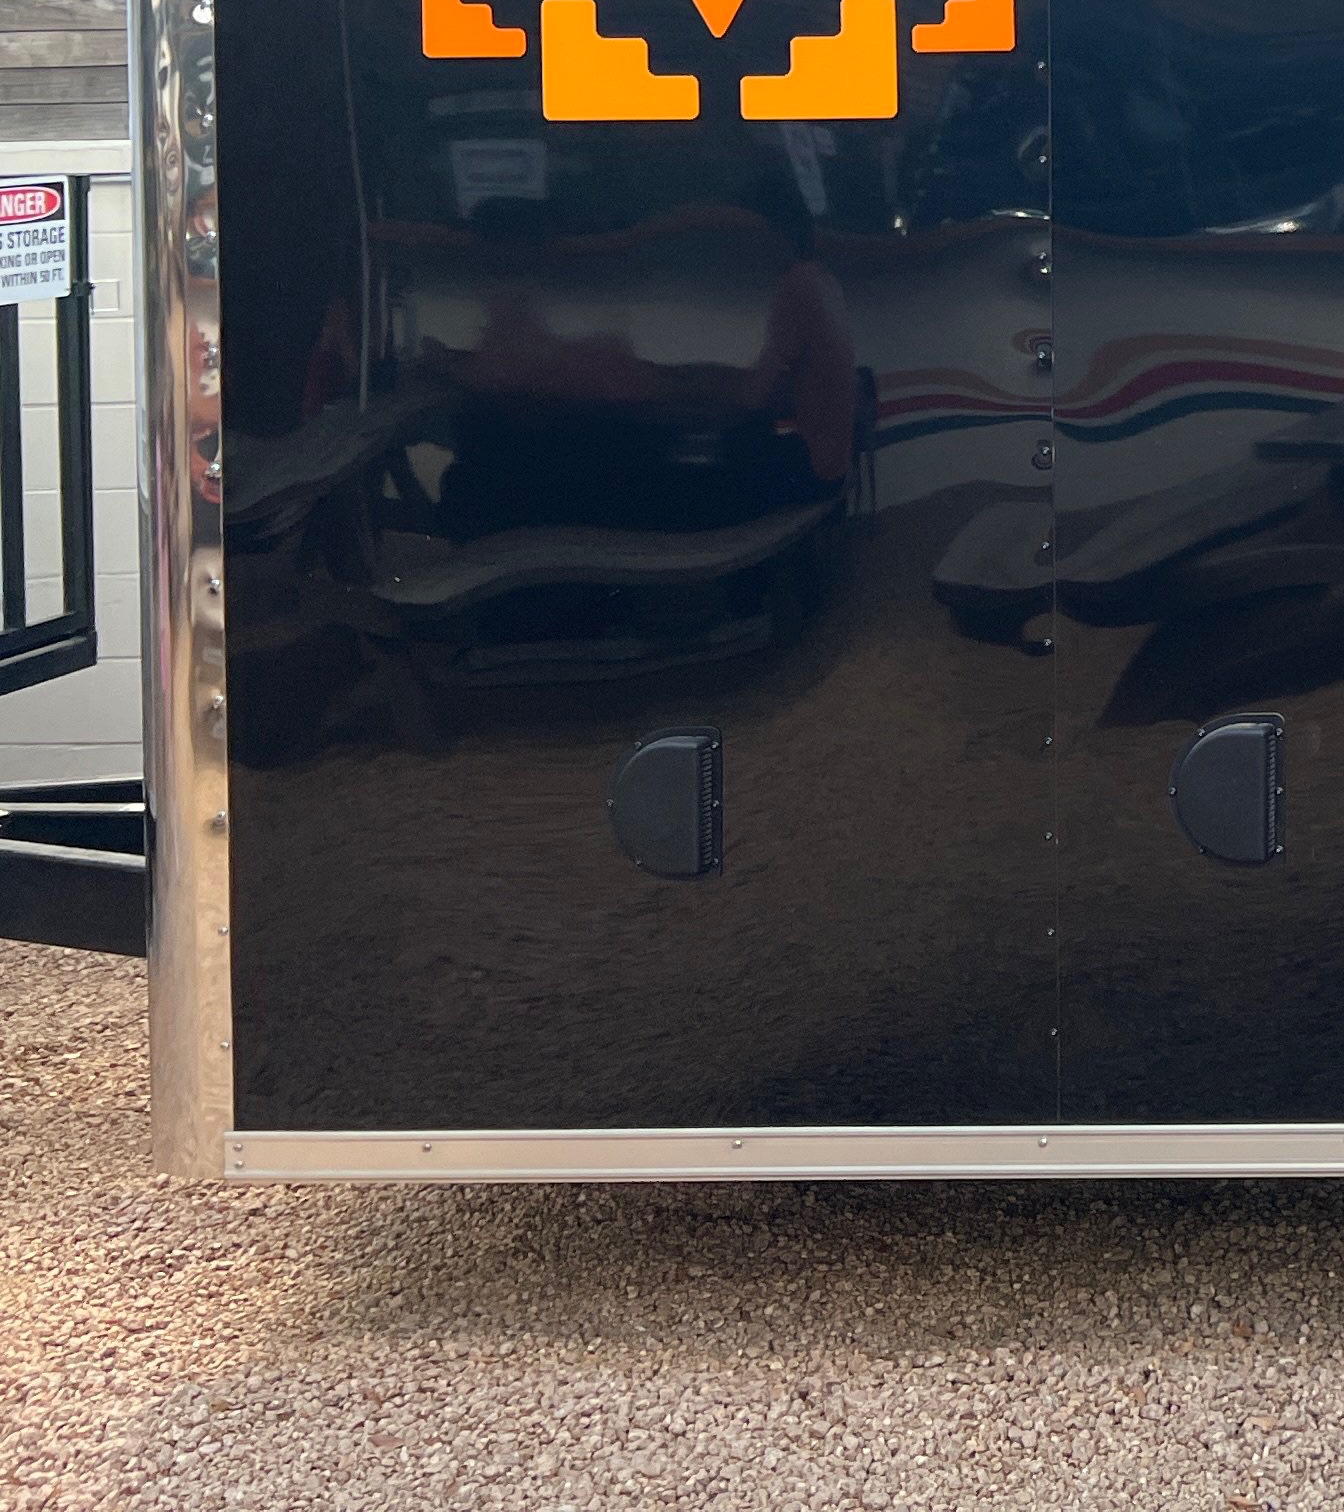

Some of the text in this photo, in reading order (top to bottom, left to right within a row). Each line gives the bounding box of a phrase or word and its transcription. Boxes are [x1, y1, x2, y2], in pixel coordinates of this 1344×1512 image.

[0, 191, 46, 216] NGER
[7, 227, 65, 248] STORAGE
[25, 252, 37, 265] OR
[41, 249, 65, 263] OPEN
[2, 271, 37, 288] WITHIN
[40, 269, 50, 282] 50
